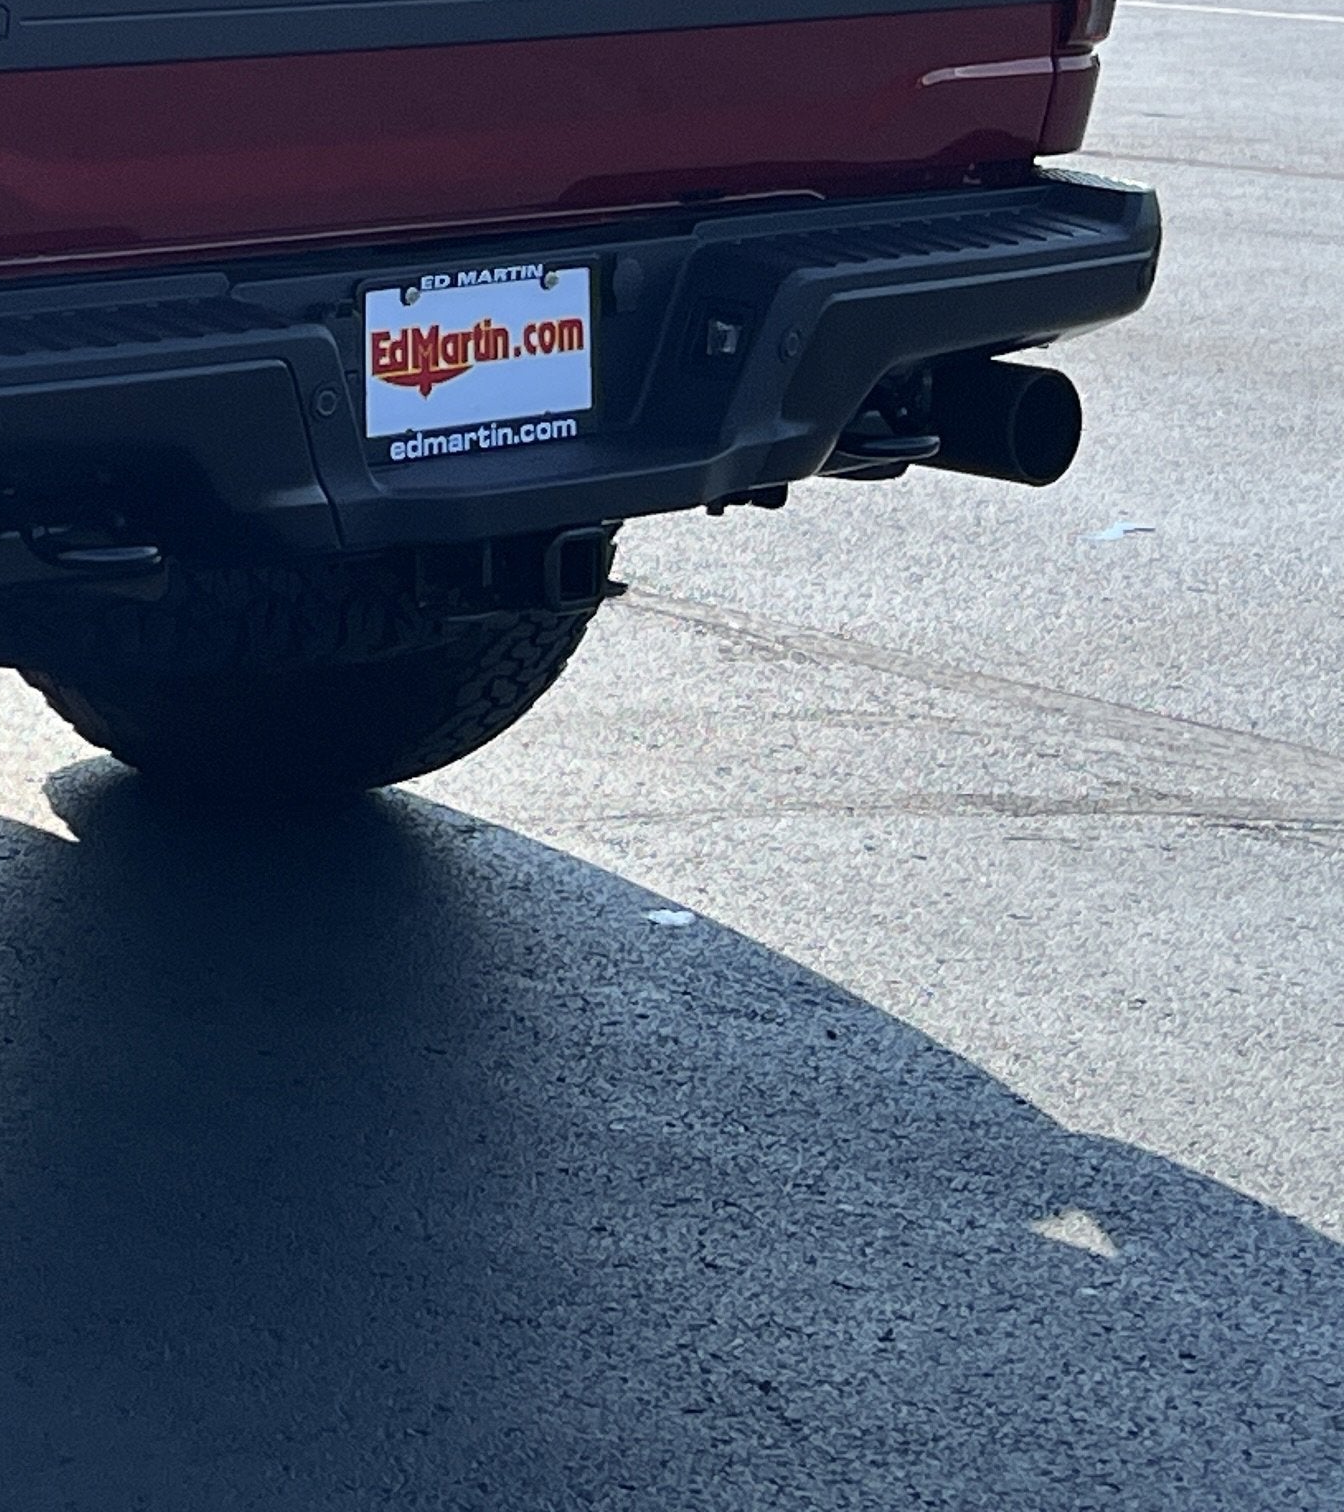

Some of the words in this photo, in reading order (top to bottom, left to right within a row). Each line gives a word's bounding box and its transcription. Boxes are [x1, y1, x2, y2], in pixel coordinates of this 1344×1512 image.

[421, 274, 451, 290] ED
[457, 263, 544, 288] MARTIN
[370, 317, 585, 380] EdMartin.com
[389, 417, 578, 461] edmartin.com
